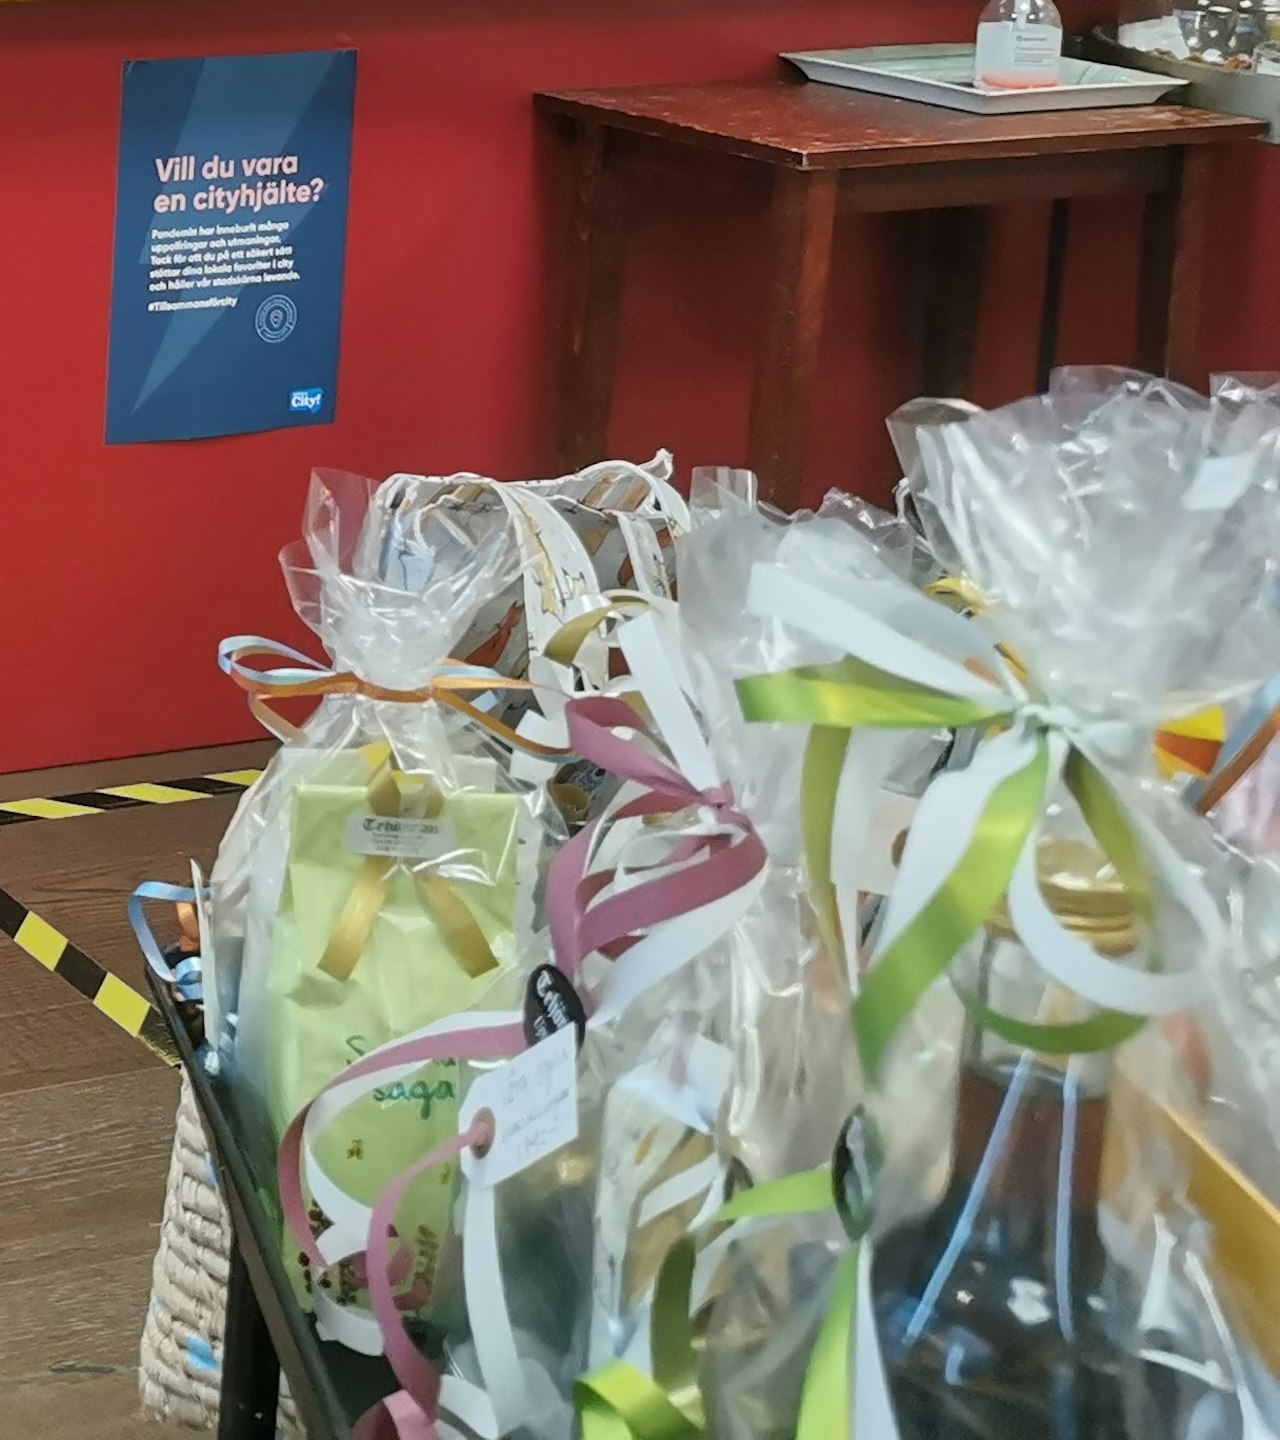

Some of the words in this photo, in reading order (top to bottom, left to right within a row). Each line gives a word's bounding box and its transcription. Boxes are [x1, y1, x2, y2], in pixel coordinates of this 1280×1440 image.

[155, 156, 195, 182] Vill
[201, 155, 235, 180] du
[241, 153, 299, 177] vara
[153, 192, 186, 213] en
[193, 178, 325, 214] cityhjälte?
[150, 255, 172, 265] Tack
[173, 253, 186, 263] för
[188, 253, 202, 263] att
[204, 252, 215, 261] du
[217, 251, 229, 262] på
[231, 250, 244, 259] ett
[246, 248, 273, 258] säkert
[275, 246, 293, 256] sätt
[290, 395, 322, 409] City!
[373, 1079, 456, 1120] saga
